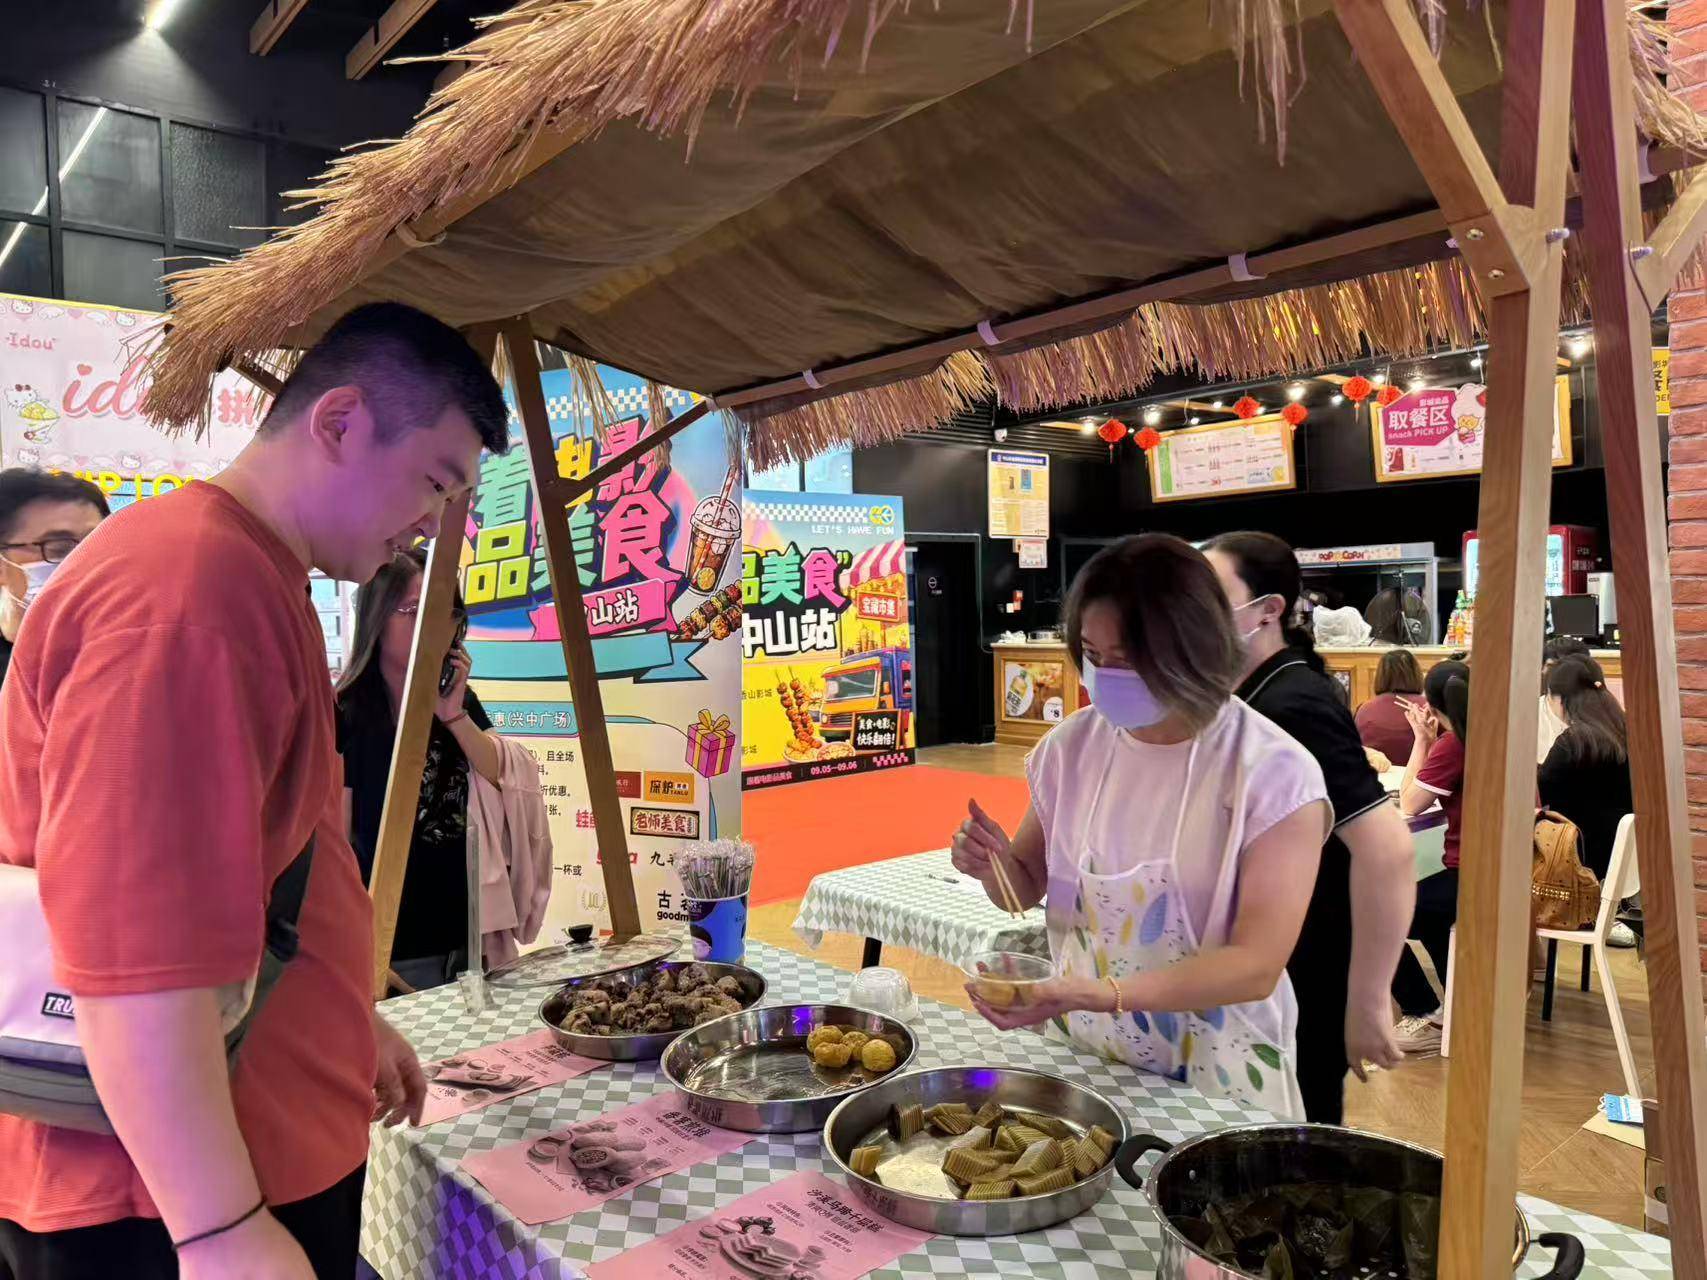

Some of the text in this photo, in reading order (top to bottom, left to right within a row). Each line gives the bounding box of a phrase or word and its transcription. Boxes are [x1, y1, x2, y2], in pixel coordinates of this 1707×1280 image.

[1388, 404, 1450, 430] 取餐区
[1414, 427, 1435, 438] PICK
[1436, 425, 1449, 435] UP
[876, 525, 895, 535] FUN
[584, 589, 640, 625] 山站
[45, 996, 74, 1013] TRU
